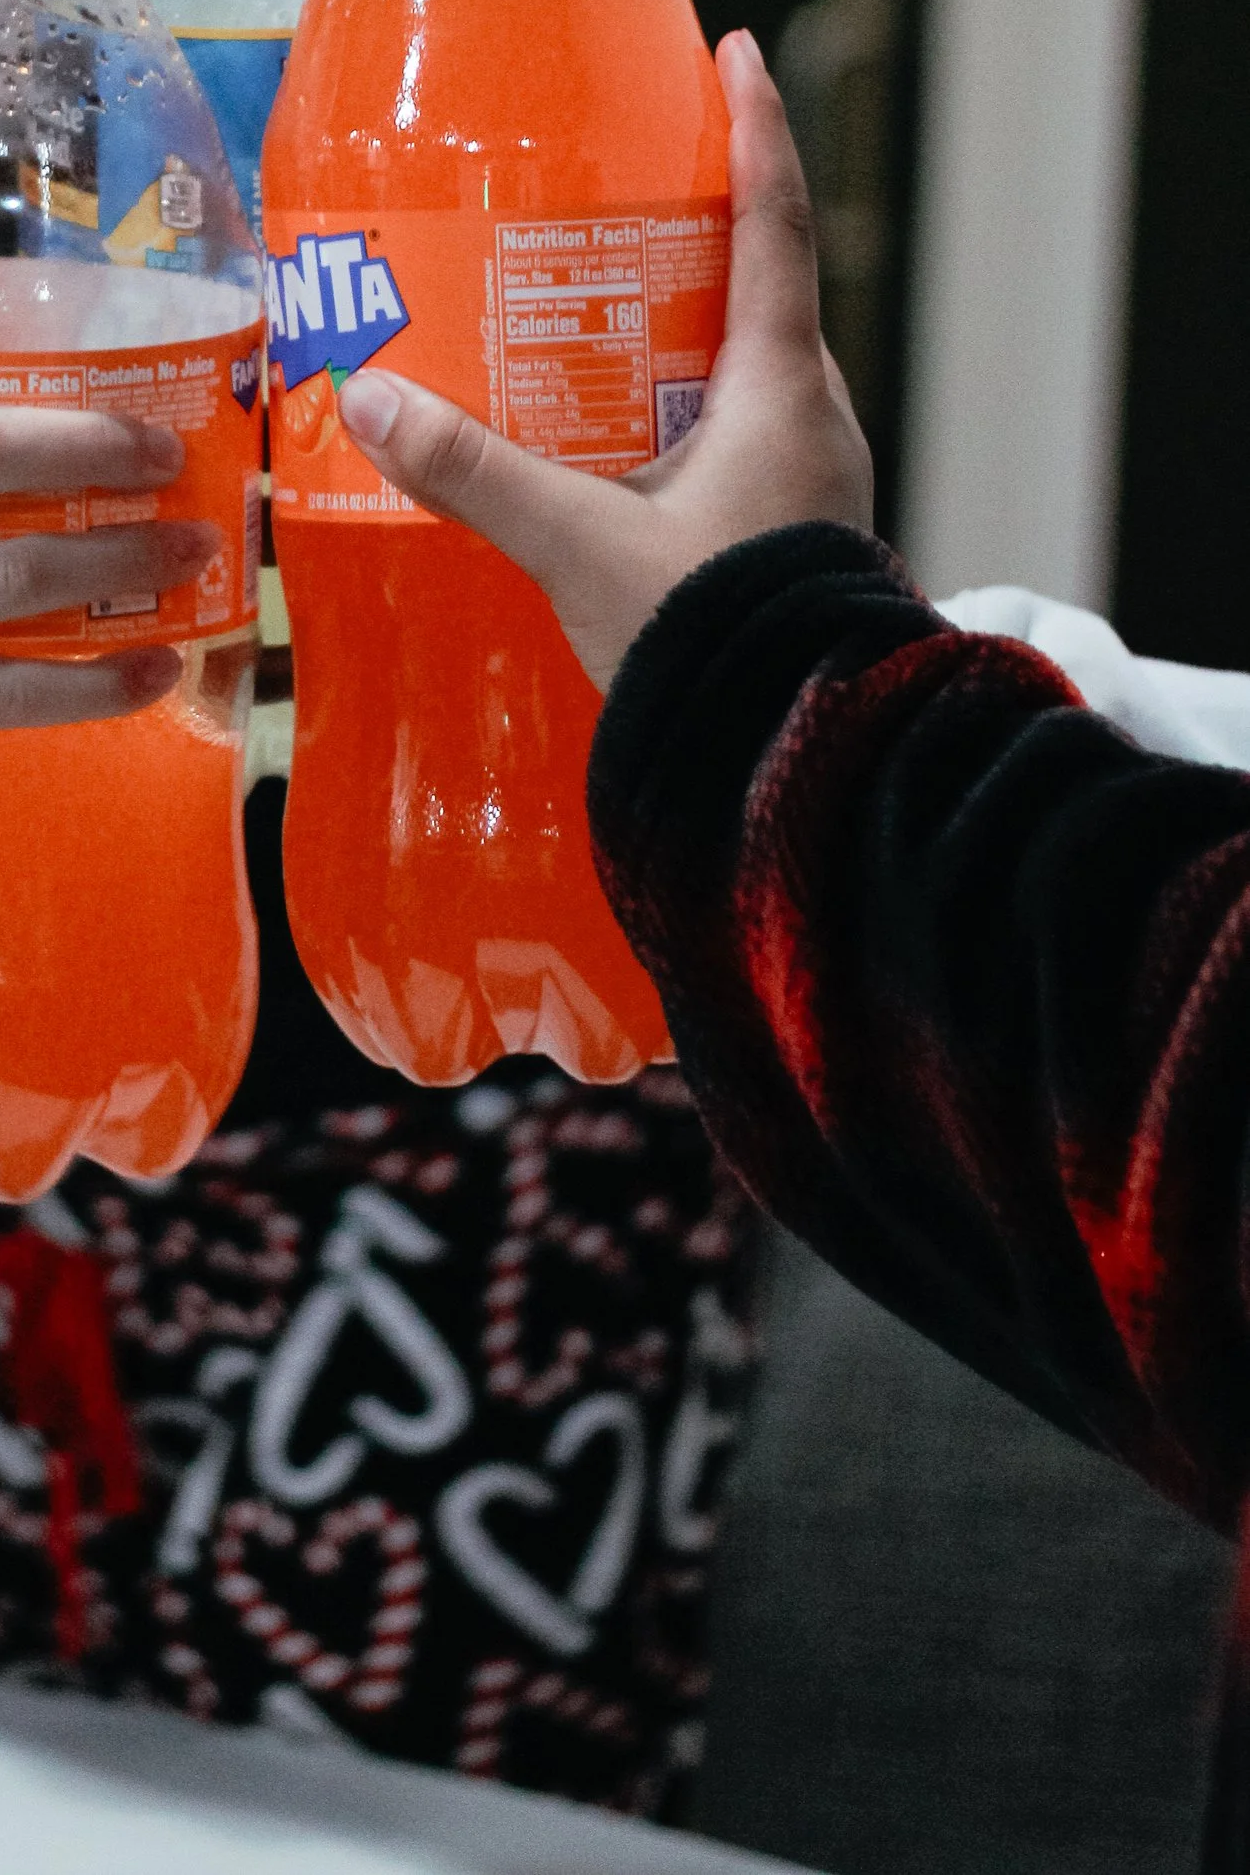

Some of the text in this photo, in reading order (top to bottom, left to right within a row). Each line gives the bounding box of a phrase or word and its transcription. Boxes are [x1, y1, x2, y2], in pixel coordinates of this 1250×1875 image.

[502, 224, 640, 250] Nutrition Facts
[646, 215, 699, 238] Contains
[503, 255, 531, 269] About
[543, 254, 582, 270] servings
[585, 254, 599, 270] per
[602, 250, 640, 265] container
[504, 271, 530, 285] Serv.
[531, 270, 553, 284] Size
[569, 267, 581, 283] 12
[268, 238, 401, 344] ANTA
[506, 299, 587, 313] Amount Per Serving
[506, 301, 644, 336] Calories 160
[89, 354, 217, 388] Contains No Juice
[508, 360, 531, 373] Total
[533, 359, 549, 371] Fat
[27, 371, 80, 394] Facts
[508, 377, 543, 389] Sodium
[509, 392, 533, 406] Total
